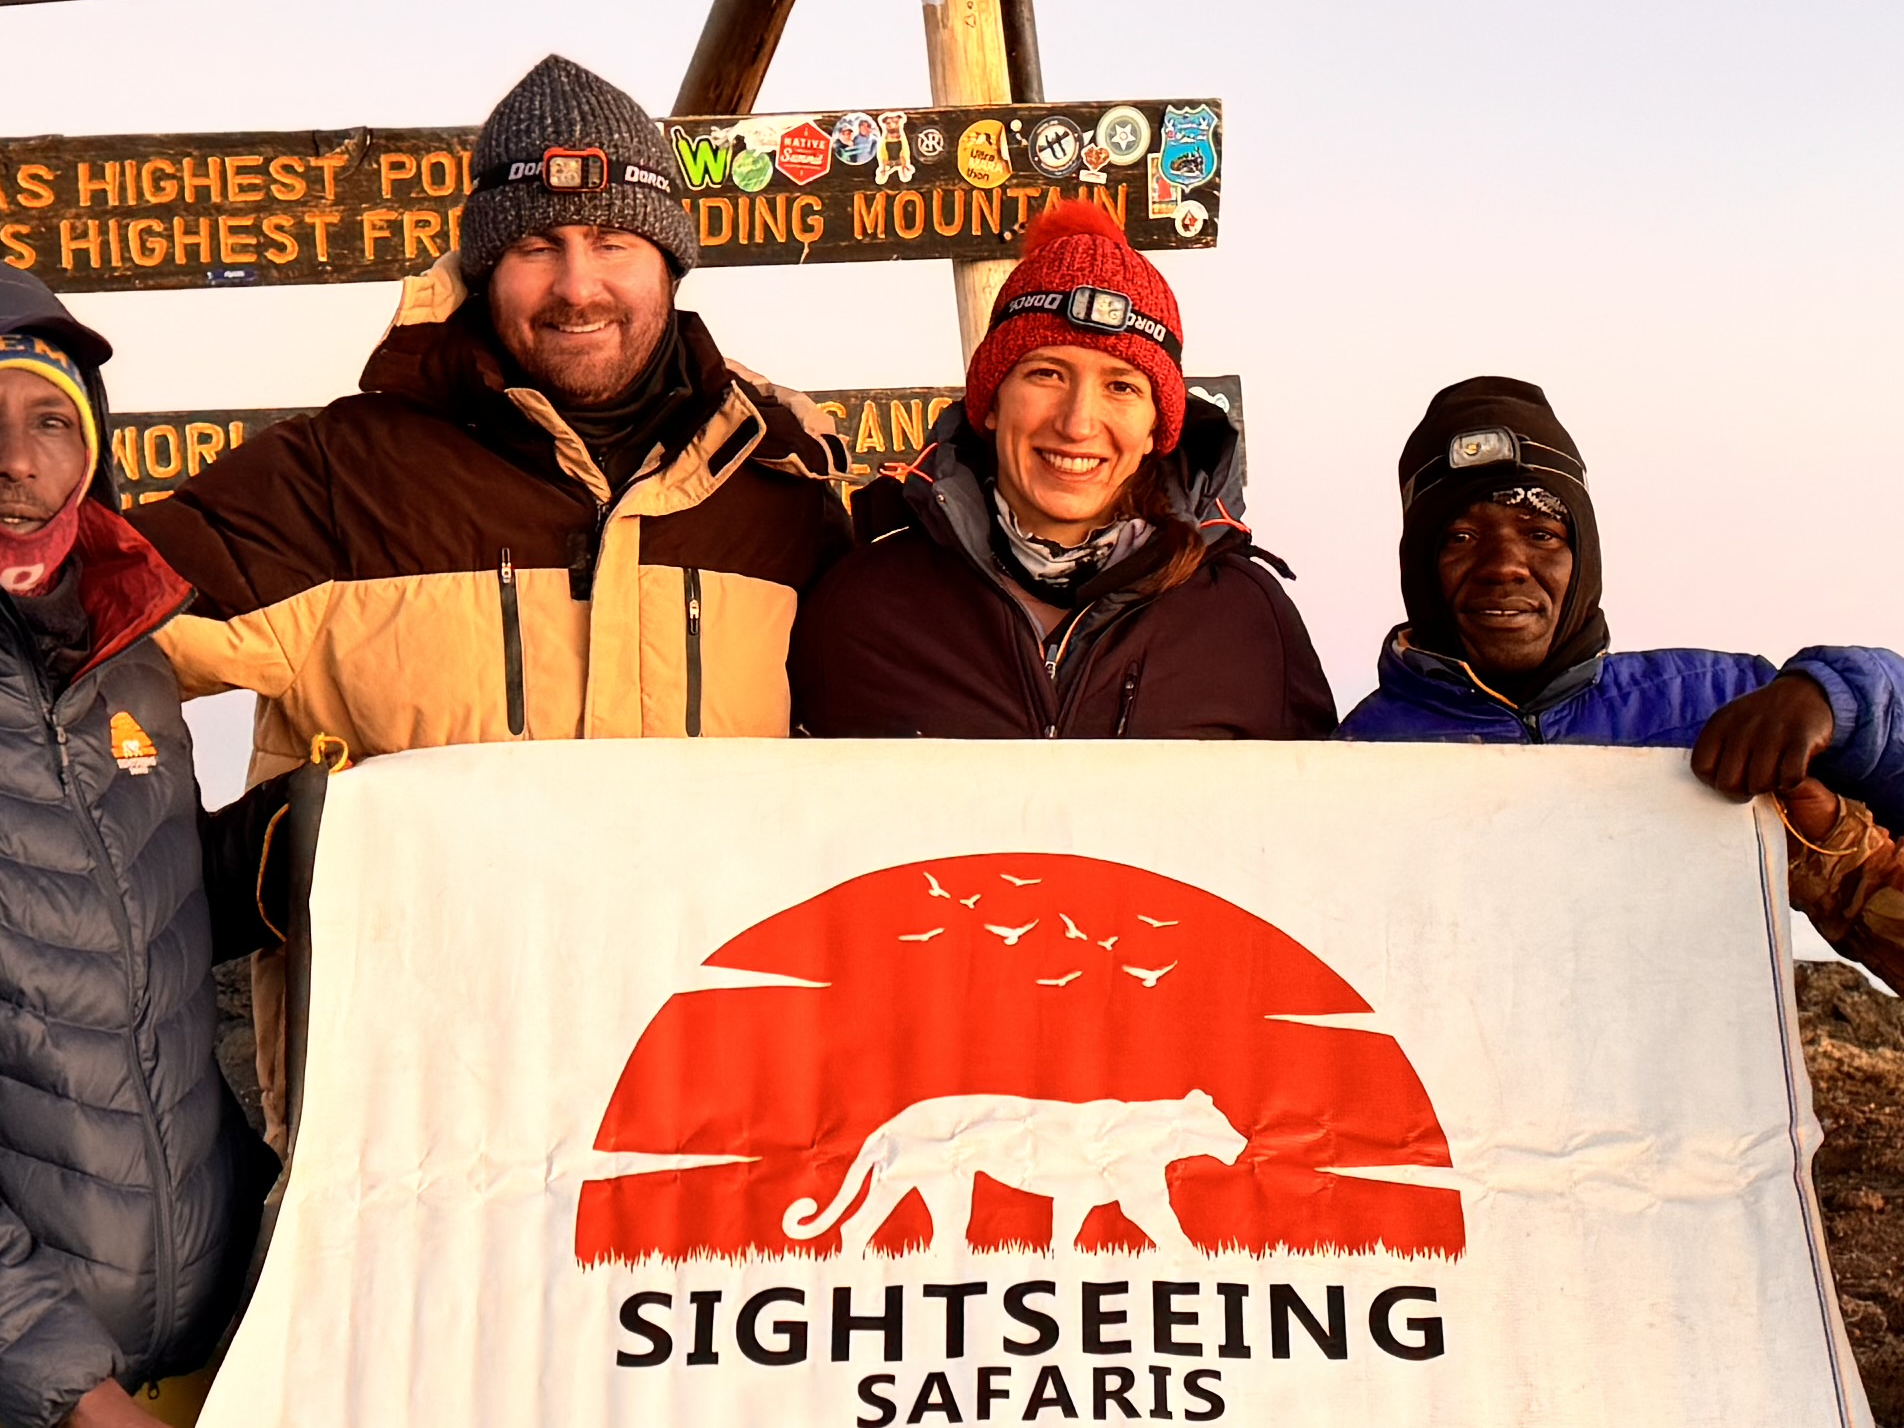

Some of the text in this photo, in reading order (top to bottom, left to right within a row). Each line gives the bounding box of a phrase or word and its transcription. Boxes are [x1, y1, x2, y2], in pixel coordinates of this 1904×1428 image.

[77, 154, 350, 207] HIGHEST
[59, 209, 342, 271] HIGHEST
[615, 1279, 1447, 1369] SIGHTSEEING
